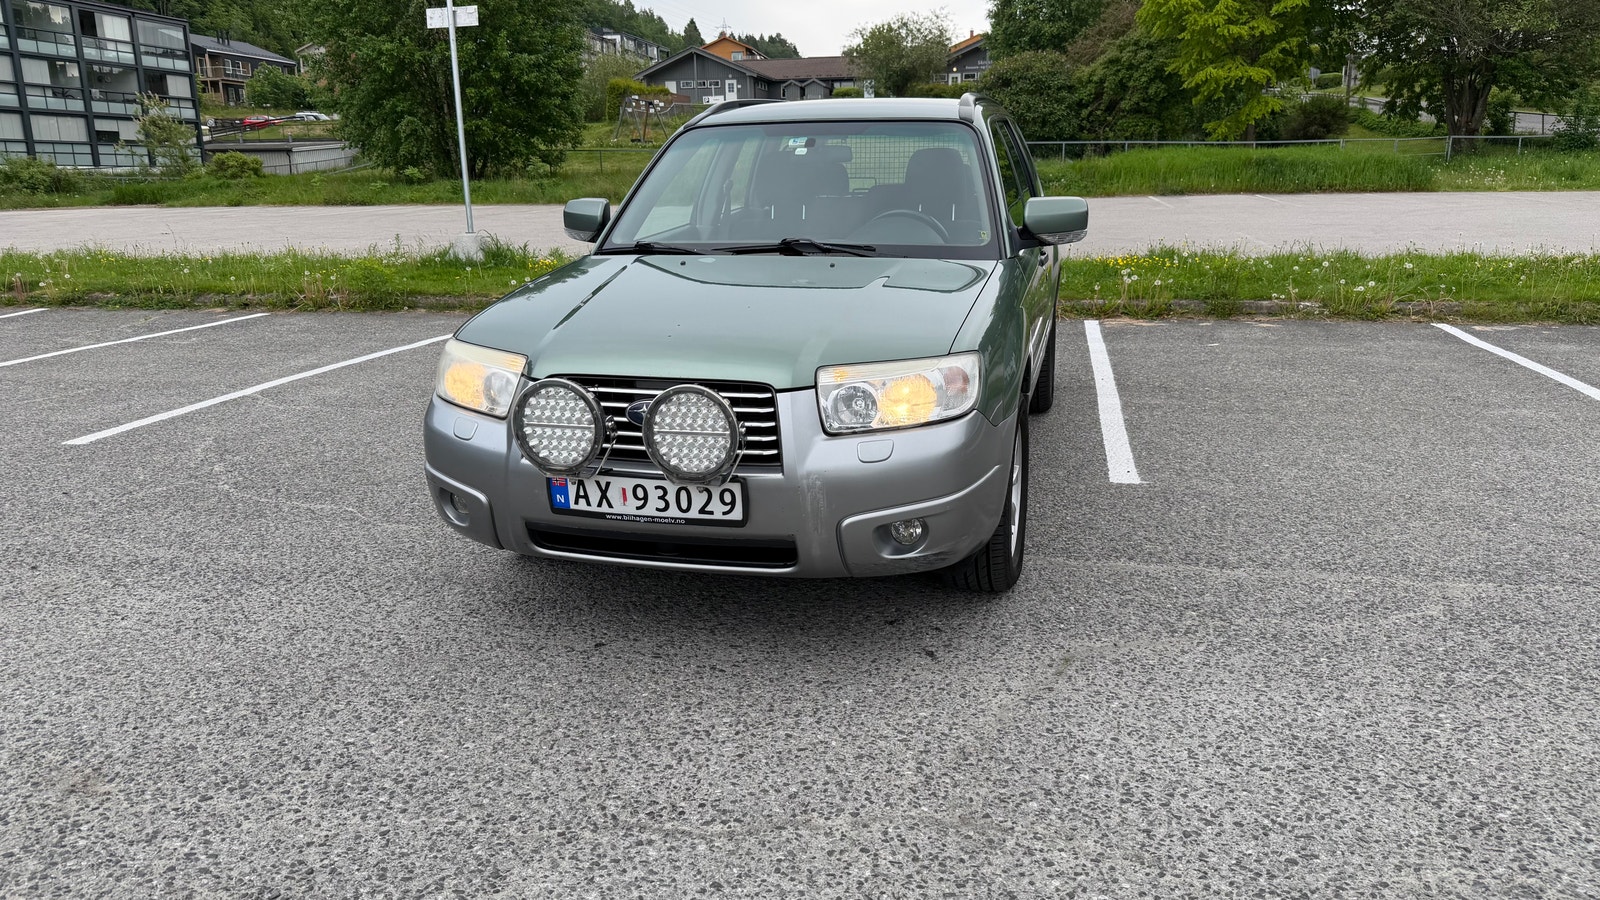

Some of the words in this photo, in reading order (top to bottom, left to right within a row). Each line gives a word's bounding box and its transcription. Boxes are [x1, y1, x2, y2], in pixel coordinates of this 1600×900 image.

[556, 494, 565, 504] N
[574, 479, 614, 509] AX
[632, 483, 736, 516] 93029
